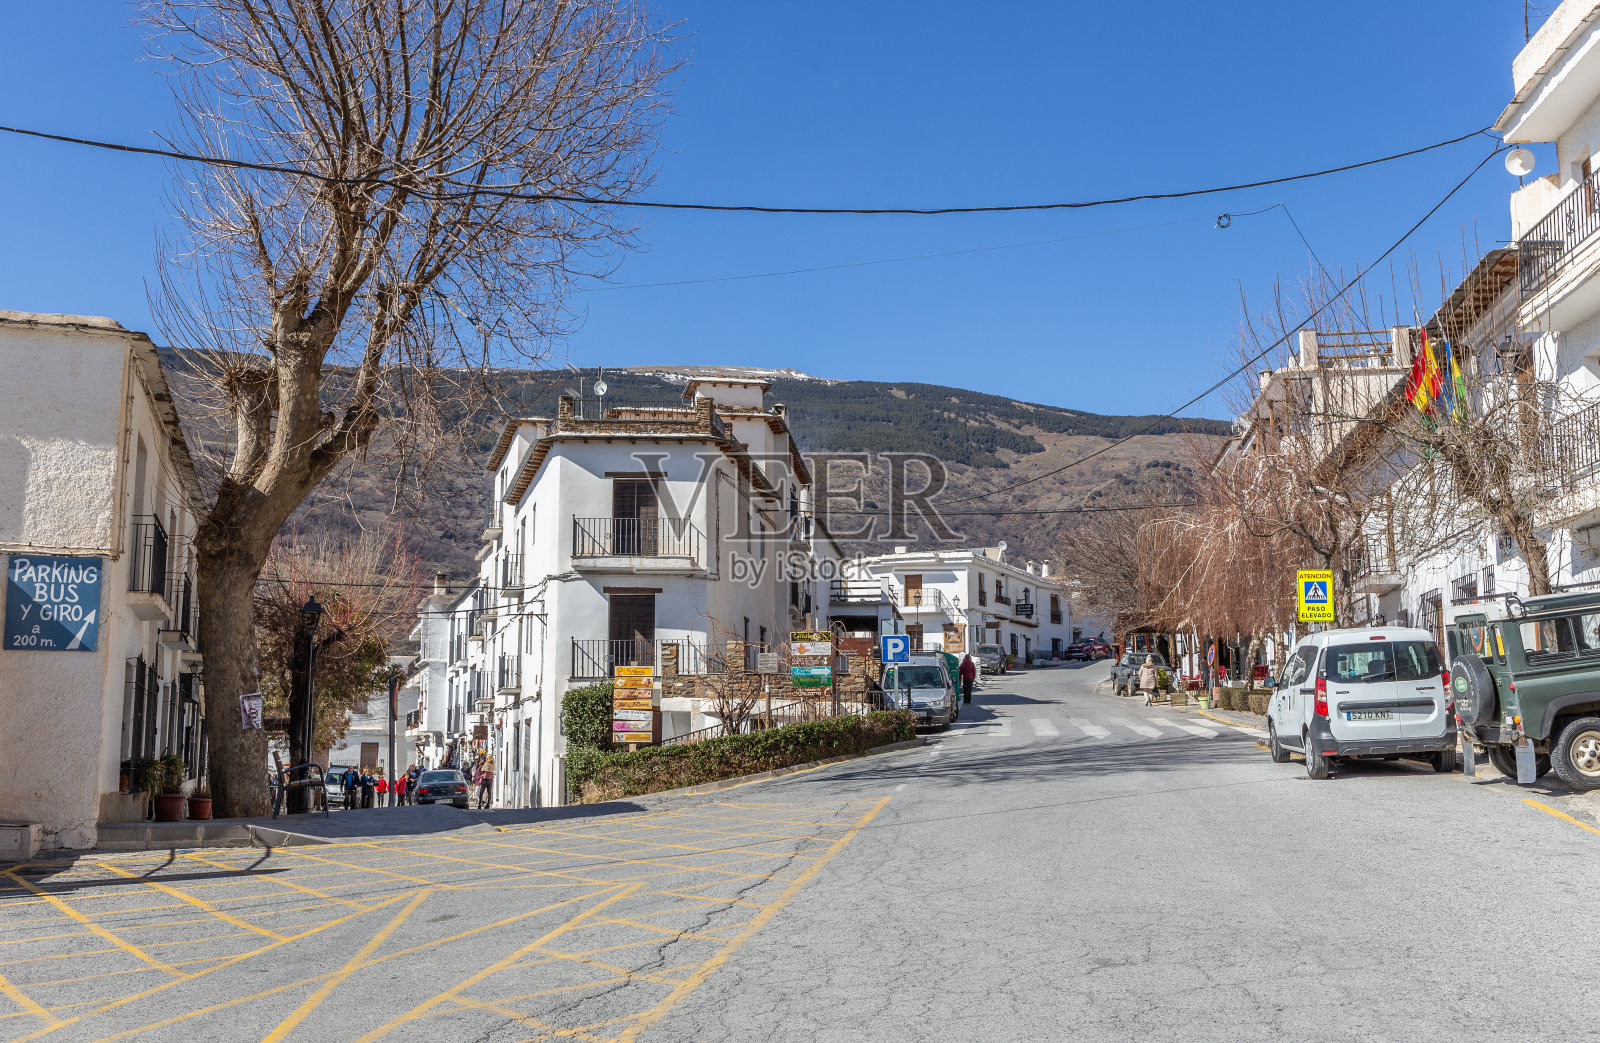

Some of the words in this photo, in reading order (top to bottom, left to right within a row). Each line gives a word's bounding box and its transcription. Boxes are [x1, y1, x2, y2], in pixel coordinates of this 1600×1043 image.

[32, 582, 79, 603] BUS
[39, 603, 83, 622] GIRO
[31, 624, 41, 634] a
[12, 634, 37, 646] 200
[40, 638, 57, 647] m.
[887, 638, 905, 660] P
[1352, 711, 1373, 720] 5210
[1374, 710, 1390, 719] KNT
